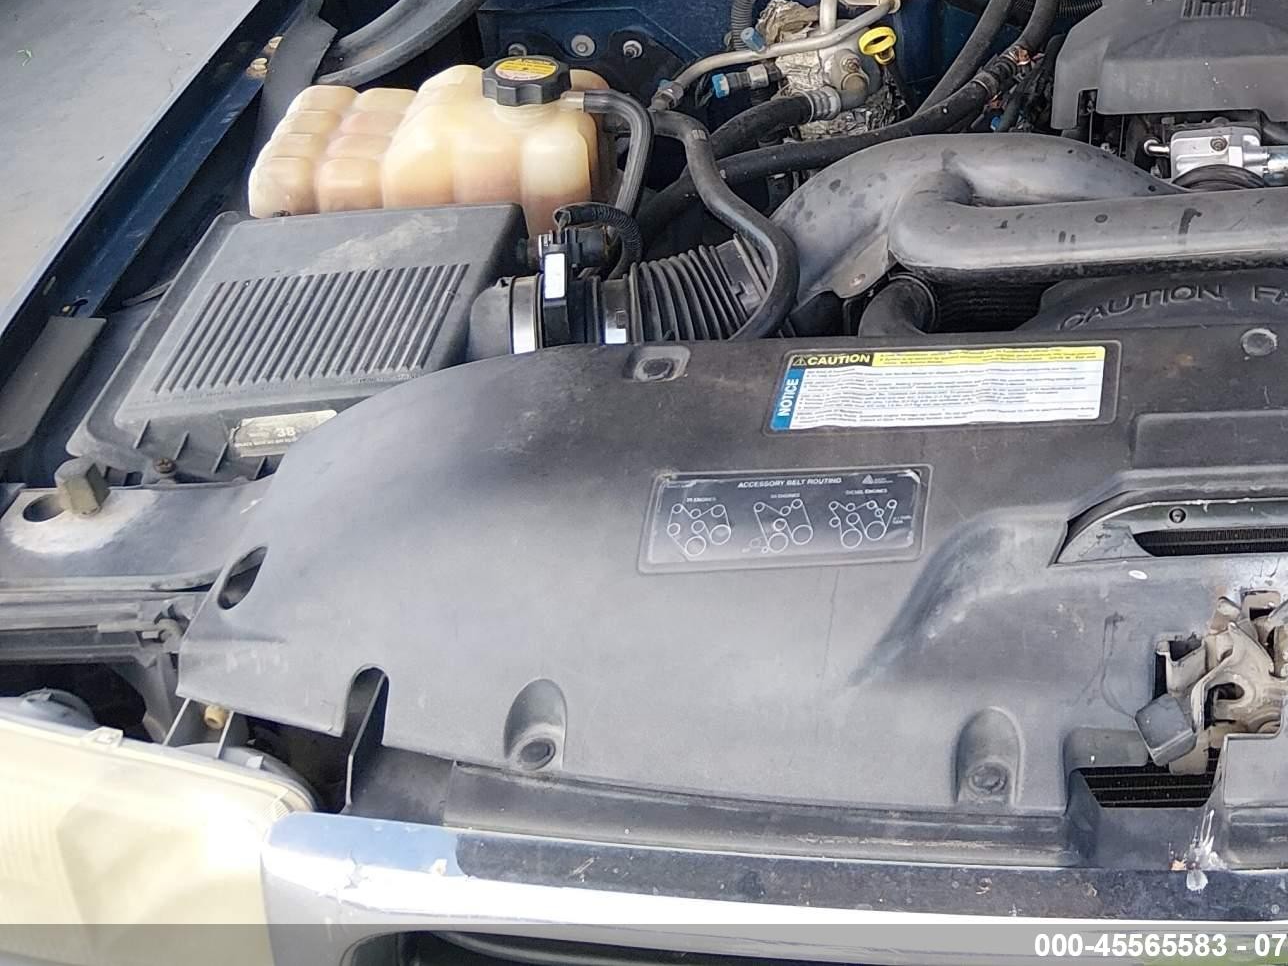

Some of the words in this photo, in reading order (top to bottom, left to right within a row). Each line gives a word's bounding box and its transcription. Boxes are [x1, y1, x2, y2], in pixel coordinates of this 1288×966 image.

[1058, 284, 1226, 331] CAUTION
[807, 353, 871, 367] CAUTION
[777, 377, 800, 417] NOTICE
[737, 480, 785, 489] ACCESSORY
[786, 478, 805, 487] BELT
[806, 476, 842, 486] ROUTING
